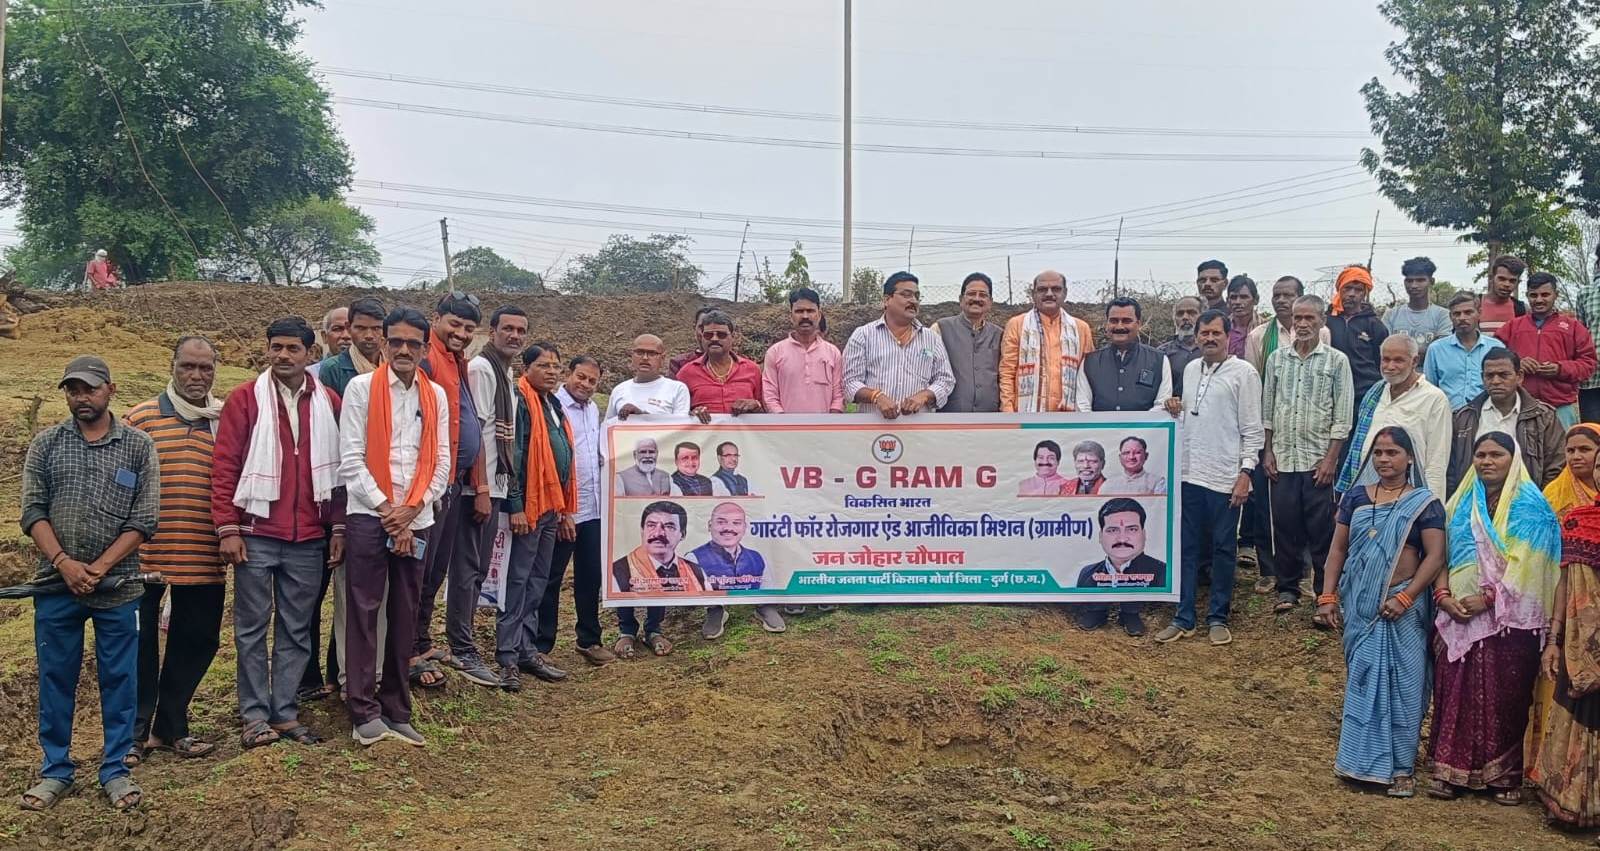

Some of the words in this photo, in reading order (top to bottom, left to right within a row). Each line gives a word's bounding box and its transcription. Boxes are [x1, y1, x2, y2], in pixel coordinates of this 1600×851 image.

[780, 466, 823, 489] VB
[856, 466, 878, 489] G
[890, 466, 963, 488] RAM
[976, 466, 998, 488] G
[844, 494, 897, 508] विकसित
[899, 497, 931, 508] भारत
[750, 514, 792, 539] गारंटी
[795, 515, 823, 538] फॉर
[826, 513, 879, 538] रोजगार
[881, 514, 901, 541] एंड
[904, 513, 978, 538] आजीविका
[981, 513, 1026, 537] मिशन
[1028, 513, 1094, 540] (ग्रामीण)
[812, 551, 845, 566] जन
[848, 545, 903, 568] जोहार
[905, 544, 965, 566] चौपाल
[798, 573, 836, 586] भारतीय
[837, 575, 867, 585] जनता
[868, 572, 891, 586] पार्टी
[892, 572, 928, 585] किसान
[929, 572, 954, 585] मोर्चा
[955, 572, 982, 584] जिला
[991, 572, 1009, 588] दुर्ग
